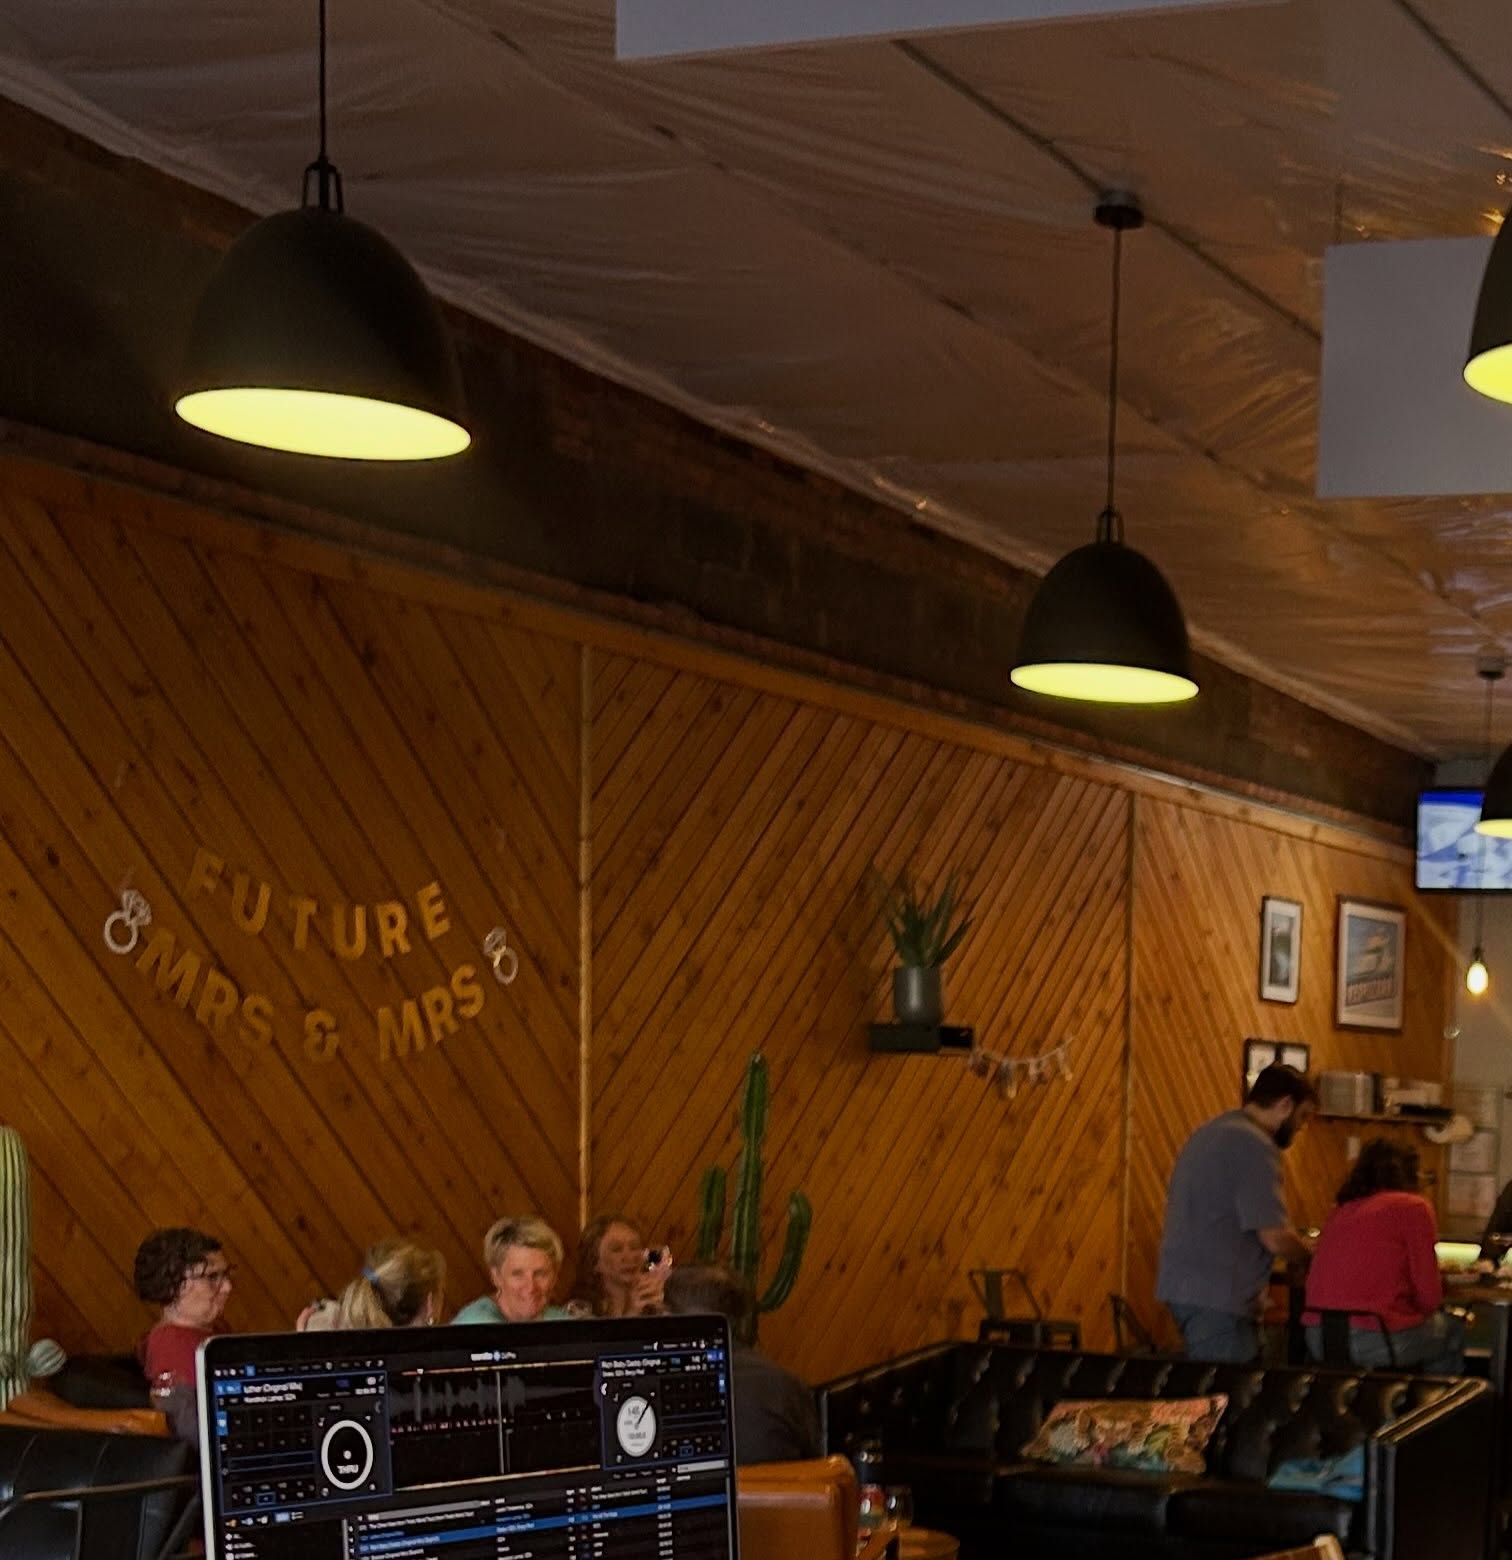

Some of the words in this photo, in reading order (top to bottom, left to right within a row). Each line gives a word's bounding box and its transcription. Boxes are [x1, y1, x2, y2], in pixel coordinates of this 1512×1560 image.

[187, 847, 451, 960] FUTURE
[134, 927, 274, 1050] MRS
[303, 1008, 340, 1063] &
[375, 963, 486, 1062] MRS
